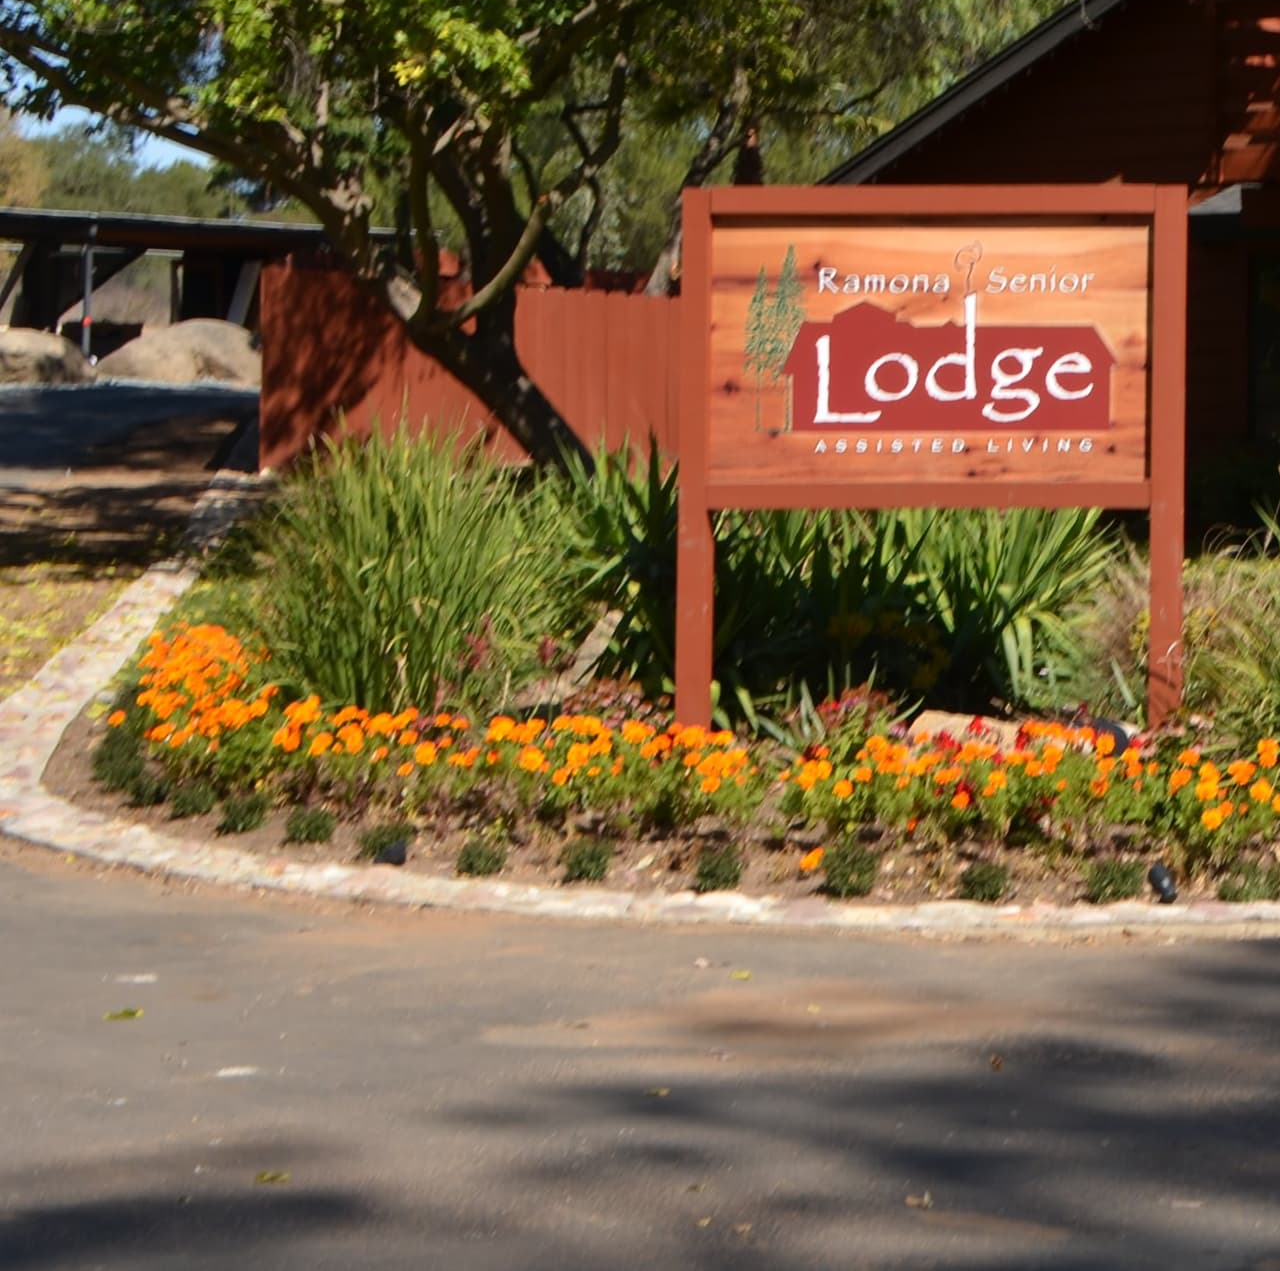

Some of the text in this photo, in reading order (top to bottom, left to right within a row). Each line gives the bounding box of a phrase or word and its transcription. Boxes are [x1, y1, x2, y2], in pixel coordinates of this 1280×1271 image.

[817, 265, 1095, 294] Ramona Senior
[813, 292, 1094, 424] Lodge
[813, 439, 1094, 454] ASSISTED LIVING
